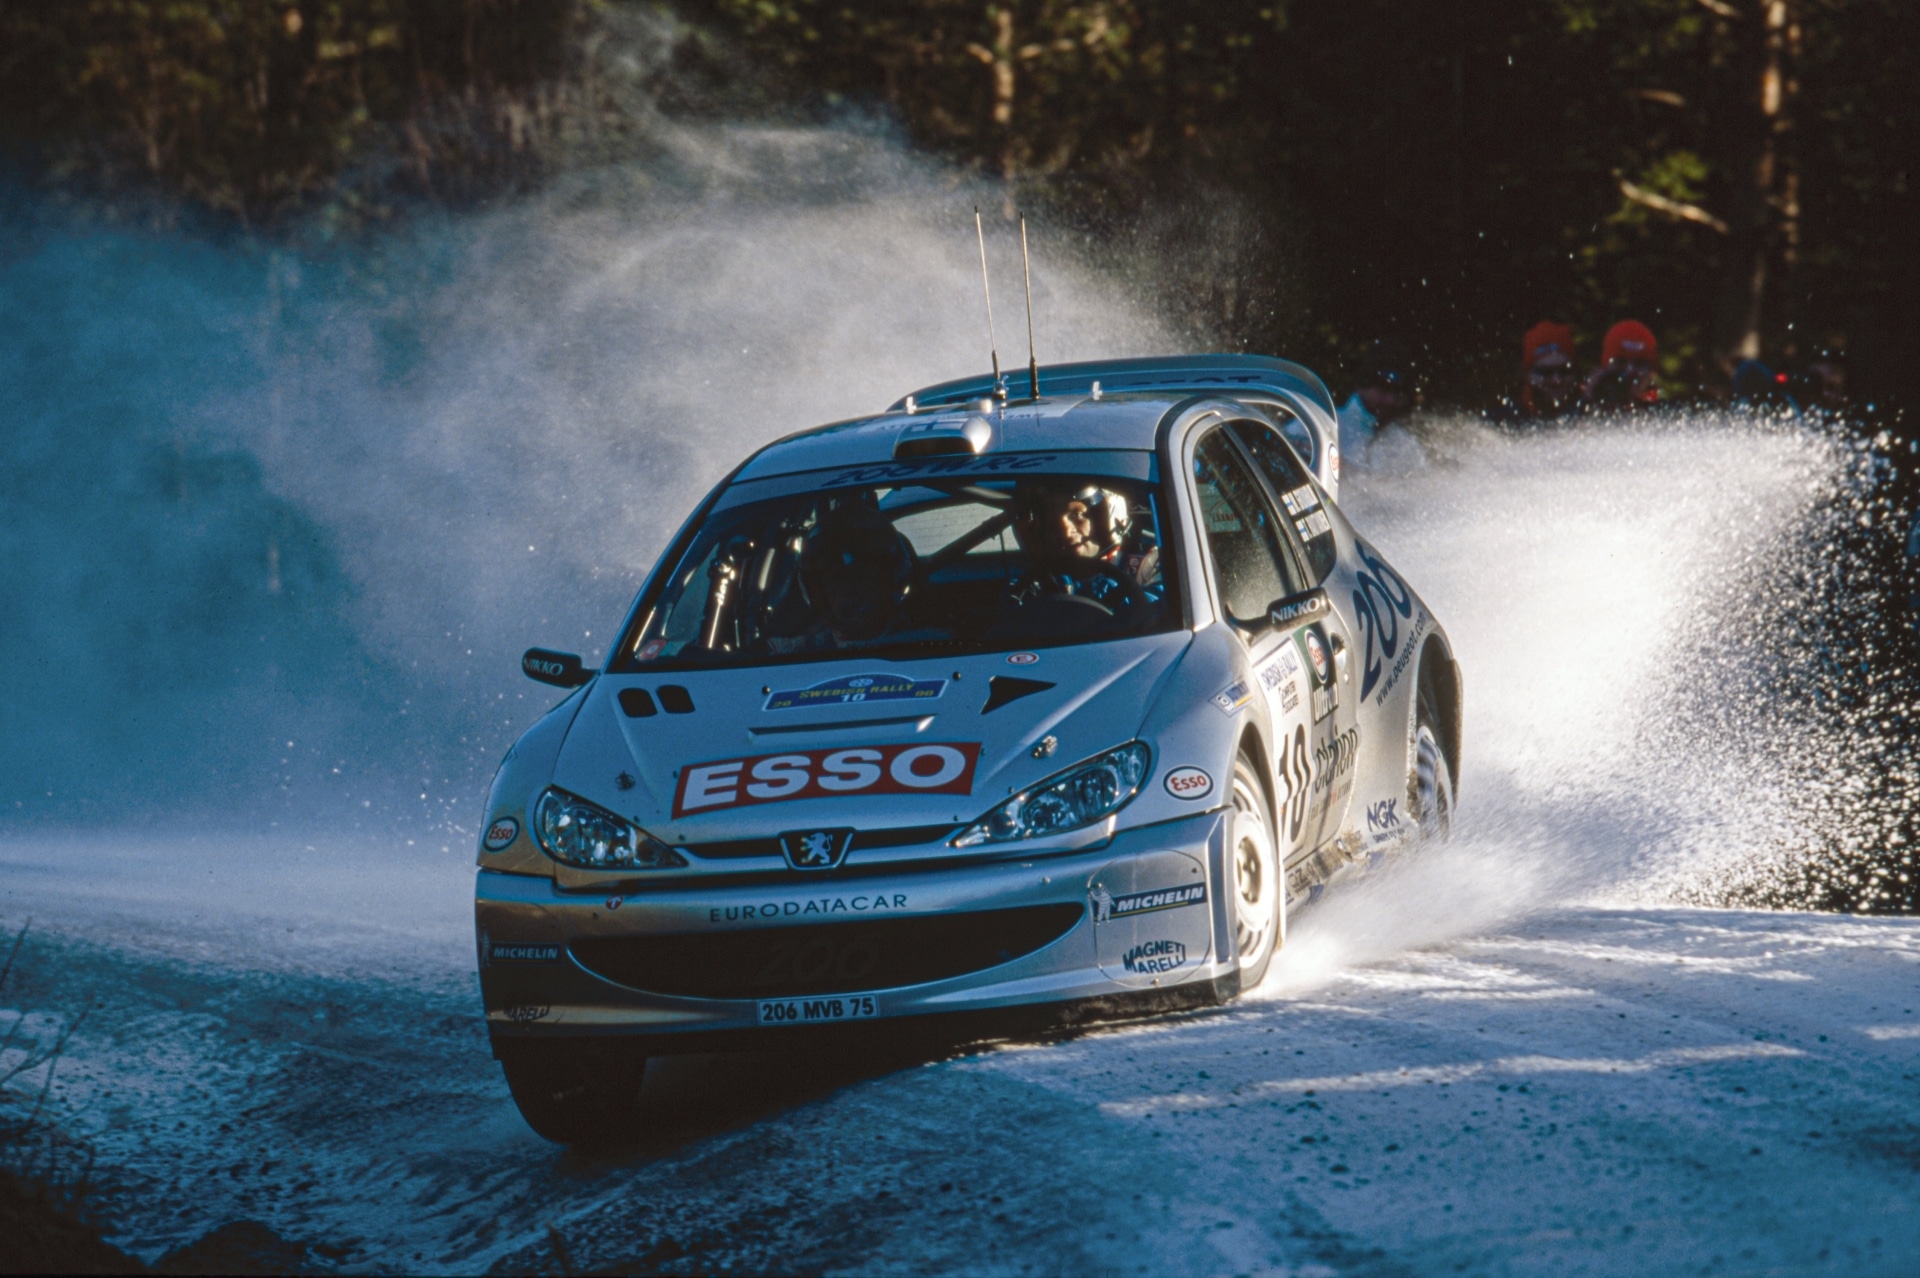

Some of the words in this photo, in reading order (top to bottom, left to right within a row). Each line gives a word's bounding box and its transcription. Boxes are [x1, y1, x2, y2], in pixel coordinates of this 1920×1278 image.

[1271, 596, 1321, 625] NIKKO
[1353, 538, 1412, 704] 206
[1375, 609, 1428, 708] www.peugeot.com
[772, 700, 792, 708] 20
[798, 687, 865, 700] SWEDISH
[869, 682, 915, 693] RALLY
[841, 693, 866, 703] 10
[1314, 724, 1358, 794] clarion
[681, 744, 967, 811] ESSO
[1278, 723, 1311, 843] 10
[1366, 798, 1400, 833] NGK
[709, 893, 908, 923] EURODATACAR
[1116, 885, 1204, 913] MICHELIN
[493, 947, 558, 960] MICHELIN
[762, 1001, 798, 1021] 206
[803, 999, 844, 1019] MVB
[850, 997, 874, 1016] 75
